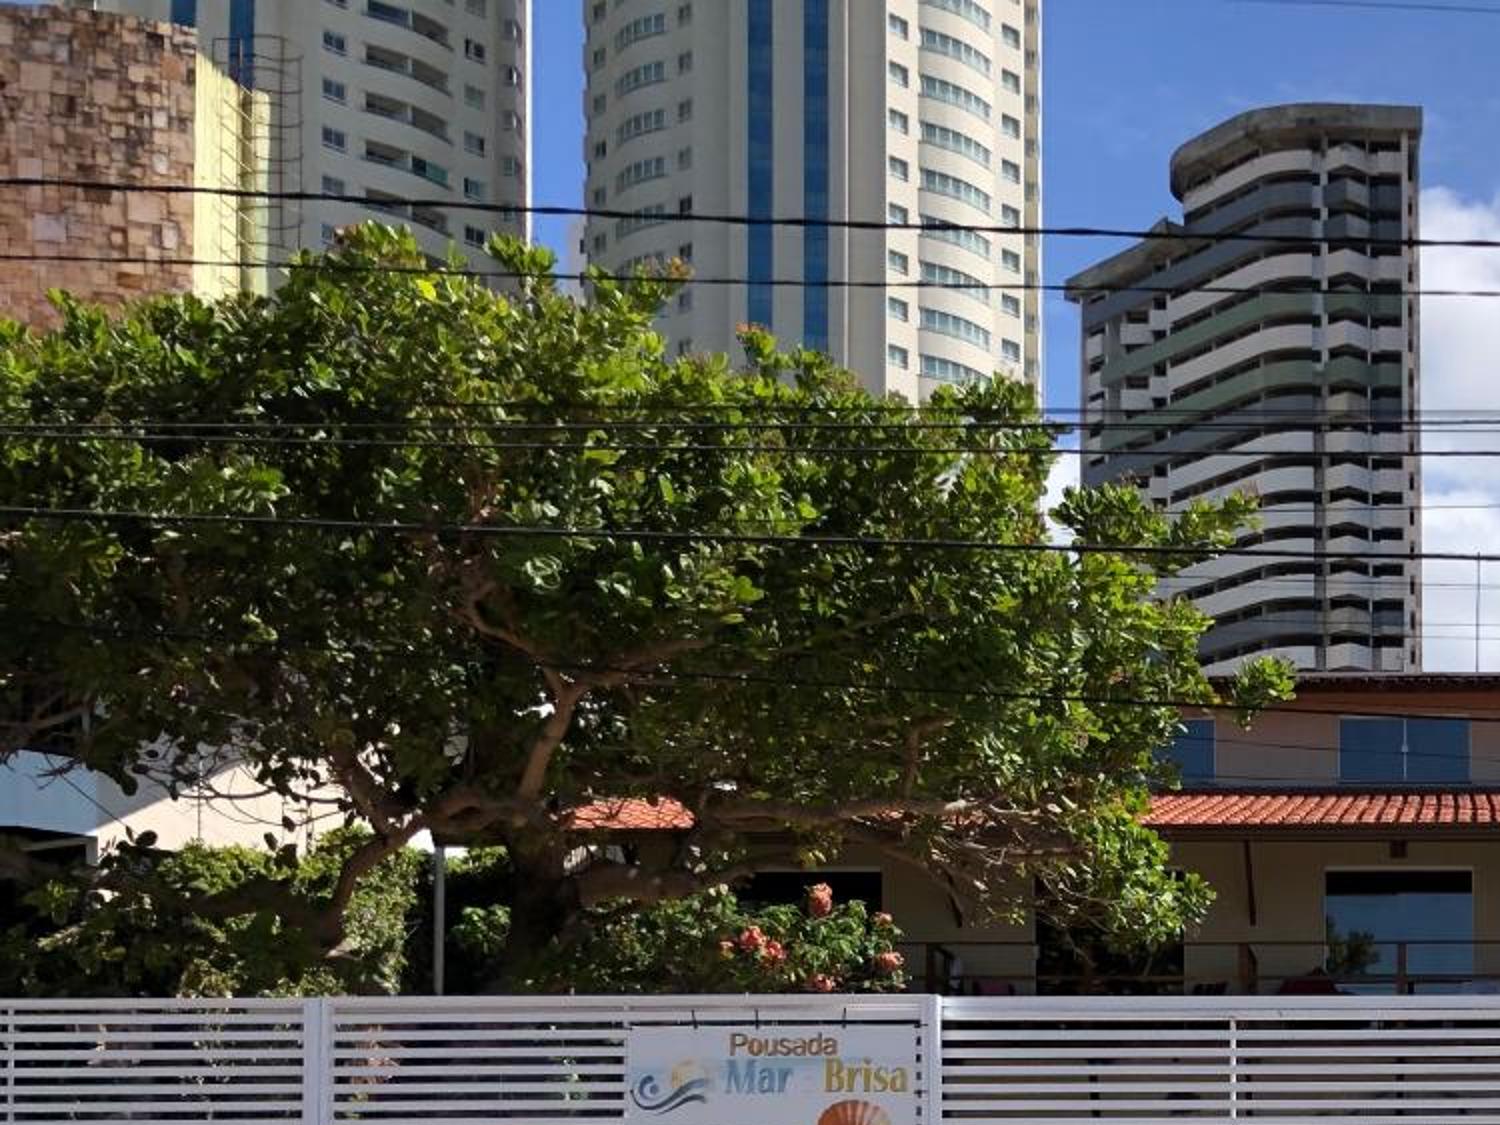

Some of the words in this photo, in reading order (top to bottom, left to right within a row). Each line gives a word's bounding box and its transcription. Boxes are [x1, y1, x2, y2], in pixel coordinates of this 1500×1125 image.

[729, 1032, 838, 1057] Pousada
[725, 1059, 793, 1094] Mar
[824, 1057, 909, 1093] Brisa
